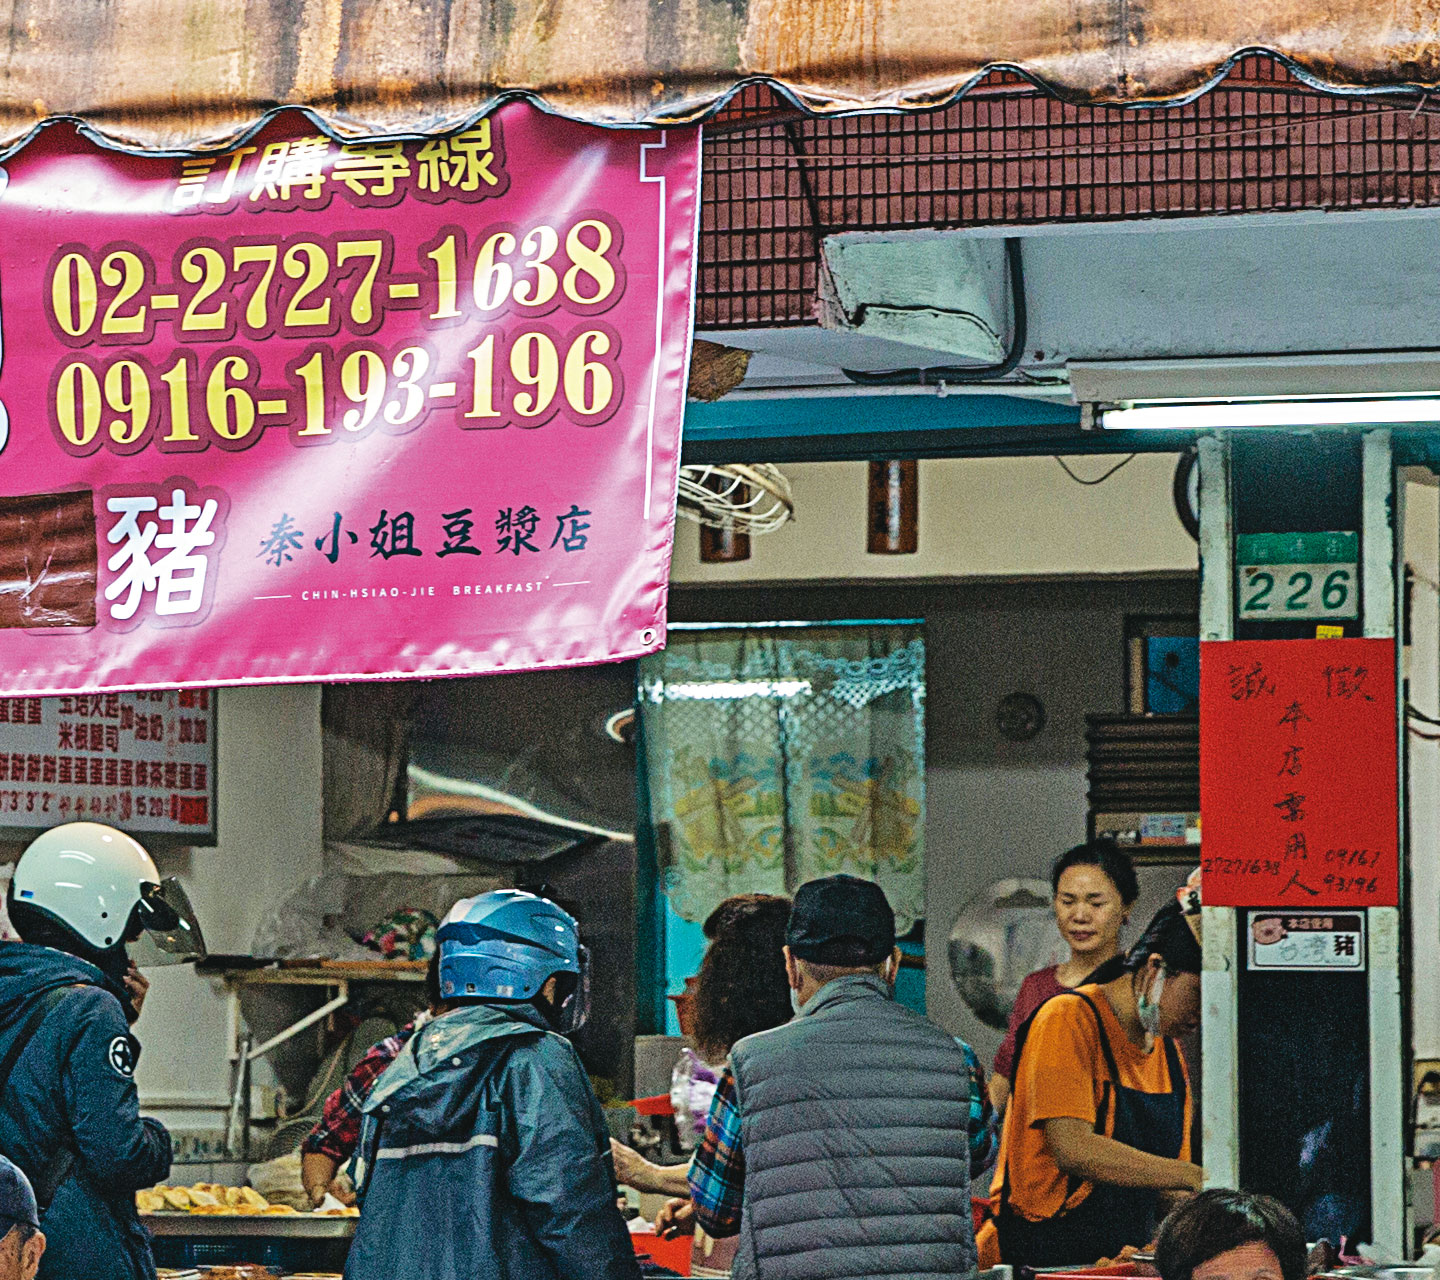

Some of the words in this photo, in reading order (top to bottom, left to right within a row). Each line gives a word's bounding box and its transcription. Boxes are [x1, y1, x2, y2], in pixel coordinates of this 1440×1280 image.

[49, 218, 620, 340] 02-2727-1638
[54, 332, 618, 449] 0916-193-196
[102, 486, 221, 622] 豬
[254, 504, 593, 568] 秦小姐豆漿店
[301, 585, 436, 601] CHIN-HSIAO-JIE
[452, 580, 543, 597] BREAKFAST
[1243, 569, 1351, 611] 226
